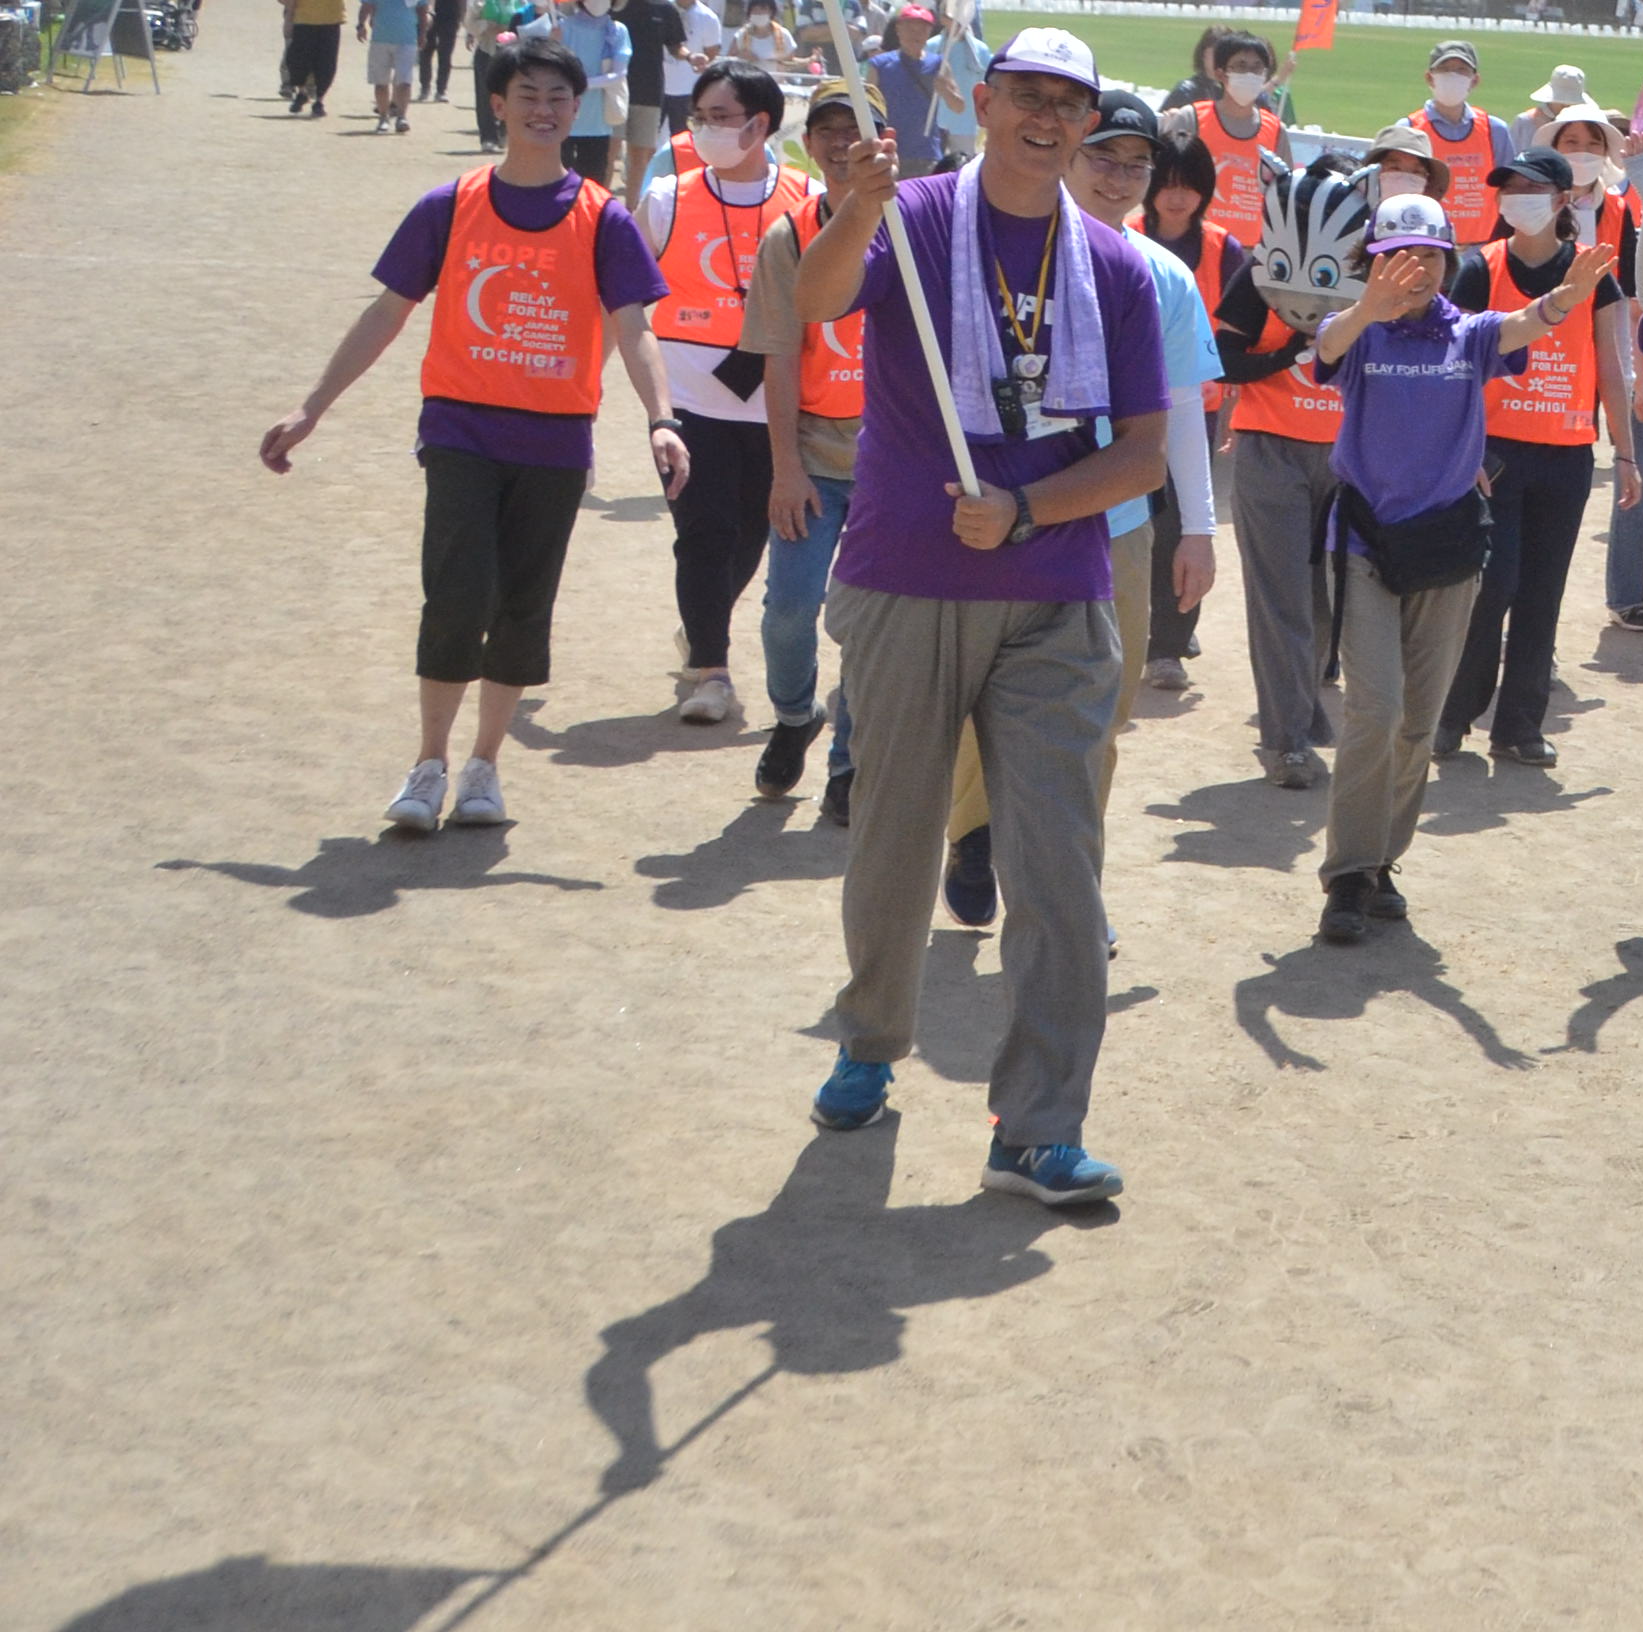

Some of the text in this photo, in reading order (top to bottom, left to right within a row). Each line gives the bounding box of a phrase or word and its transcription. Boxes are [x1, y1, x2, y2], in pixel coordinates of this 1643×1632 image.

[466, 241, 557, 270] HOPE
[510, 291, 555, 307] RELAY
[508, 304, 569, 322] FOR LIFE
[525, 322, 559, 332] JAPAN
[522, 331, 566, 343] CANCER
[522, 340, 566, 352] SOCIETY
[469, 346, 557, 369] TOCHIGI
[1532, 351, 1566, 362] RELAY
[1364, 363, 1394, 375] ELAY
[1397, 365, 1419, 375] FOR
[1532, 361, 1577, 374] FOR LIFE
[1293, 396, 1345, 413] TOCH
[1502, 399, 1566, 414] TOCHIGI
